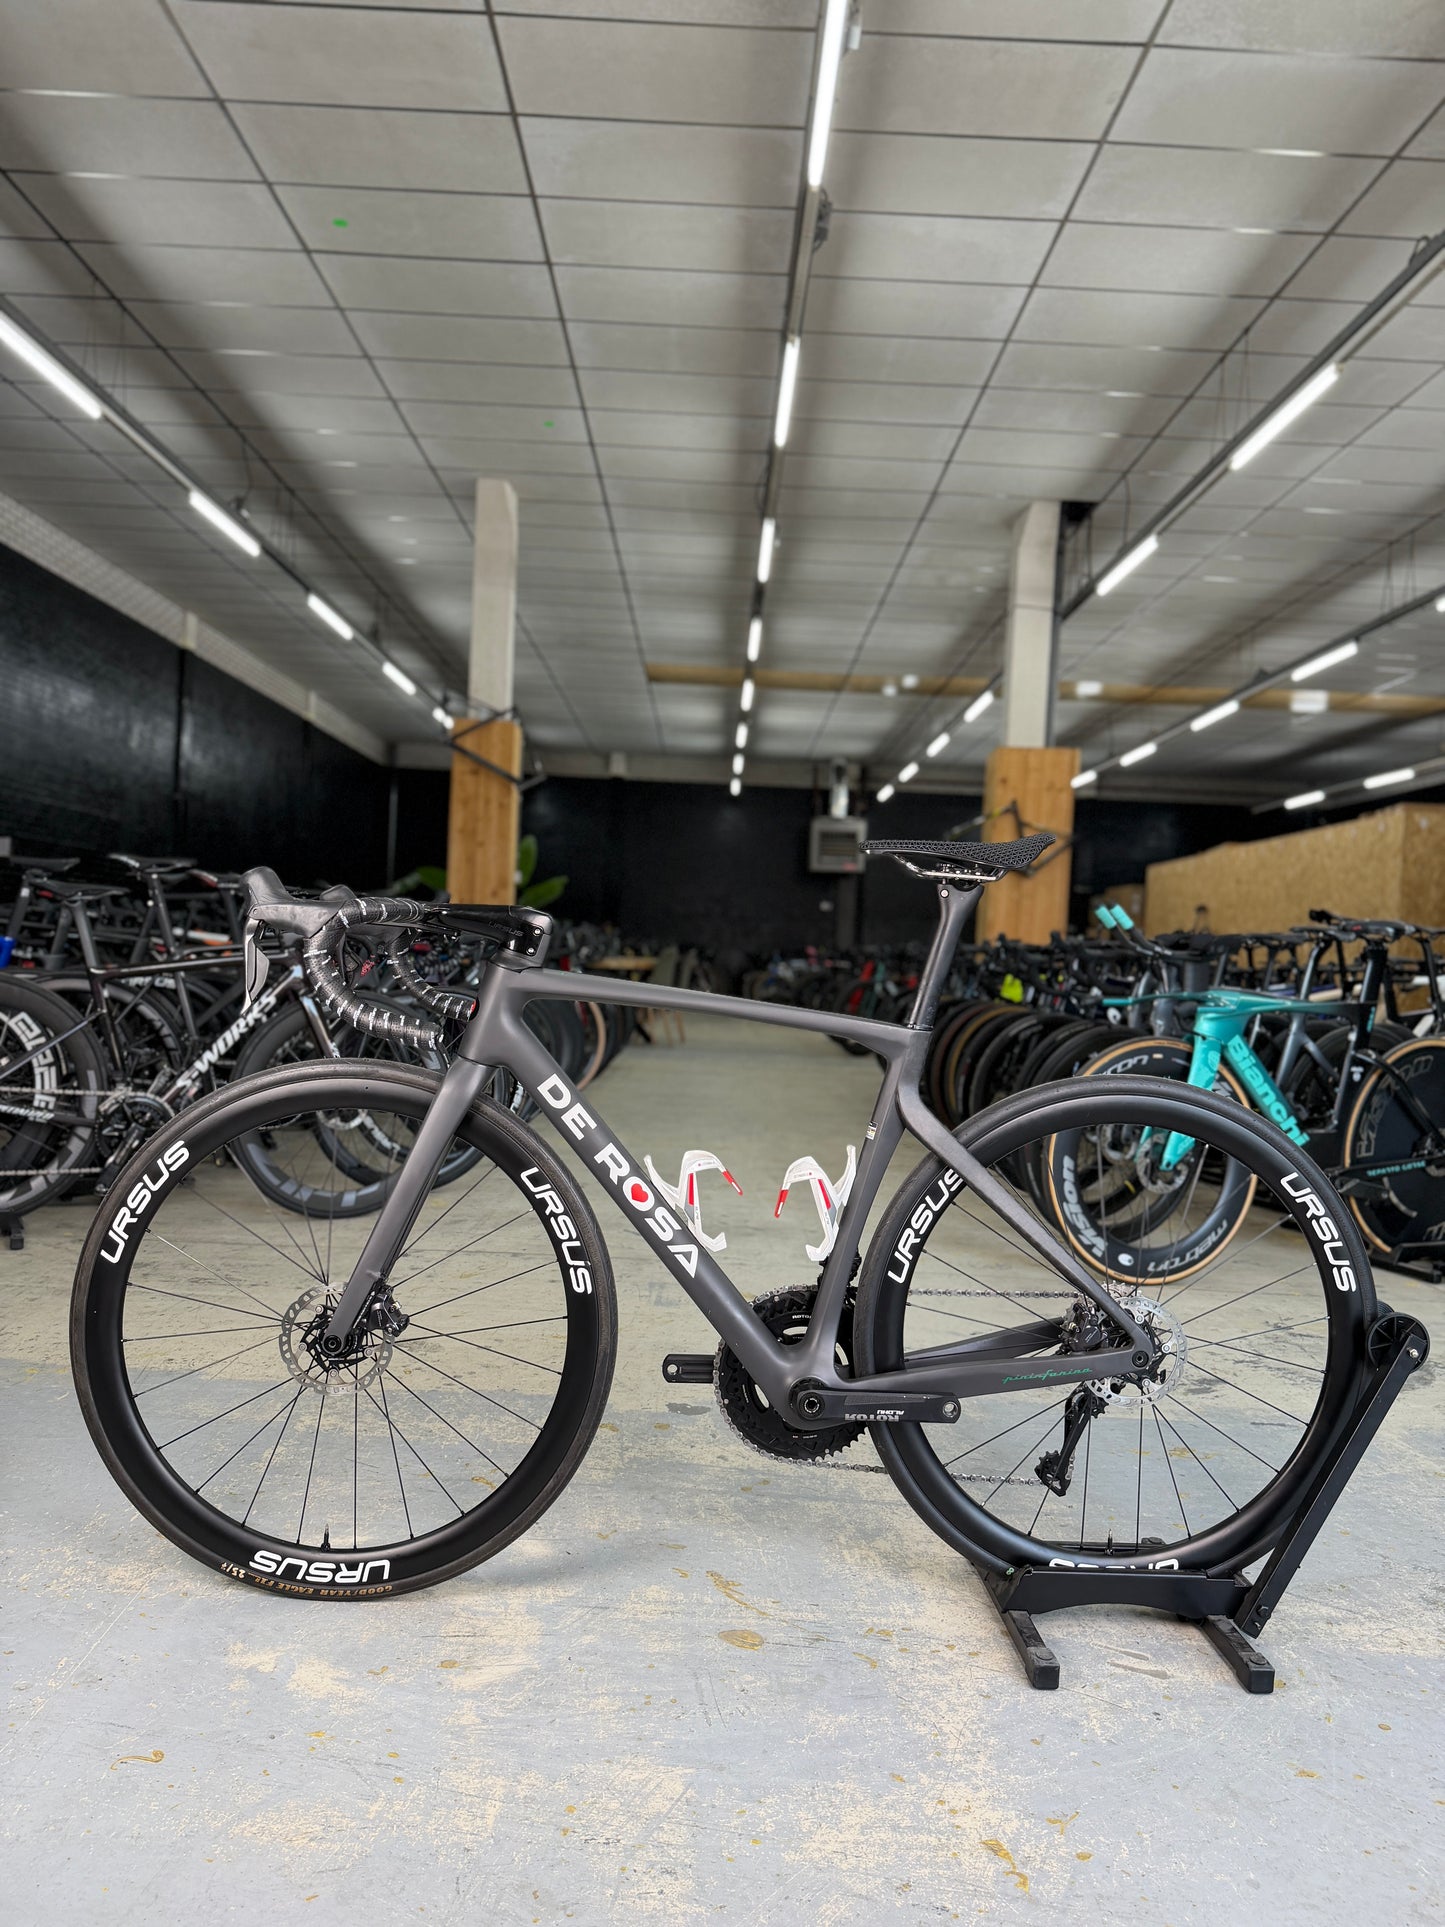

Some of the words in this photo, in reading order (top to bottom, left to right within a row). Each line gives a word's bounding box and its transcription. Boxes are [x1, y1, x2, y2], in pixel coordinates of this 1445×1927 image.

[1227, 1034, 1310, 1147] Bianchi
[100, 1140, 190, 1264] URSUS
[520, 1166, 592, 1295] URSUS
[537, 1073, 597, 1141] DE
[593, 1142, 699, 1279] ROSA
[887, 1168, 964, 1284] URSUS
[1280, 1171, 1357, 1292] URSUS
[844, 1413, 900, 1423] ROTOR
[1002, 1367, 1094, 1385] pininfarina
[249, 1550, 391, 1584] URSUS
[275, 1582, 315, 1595] EAGLE
